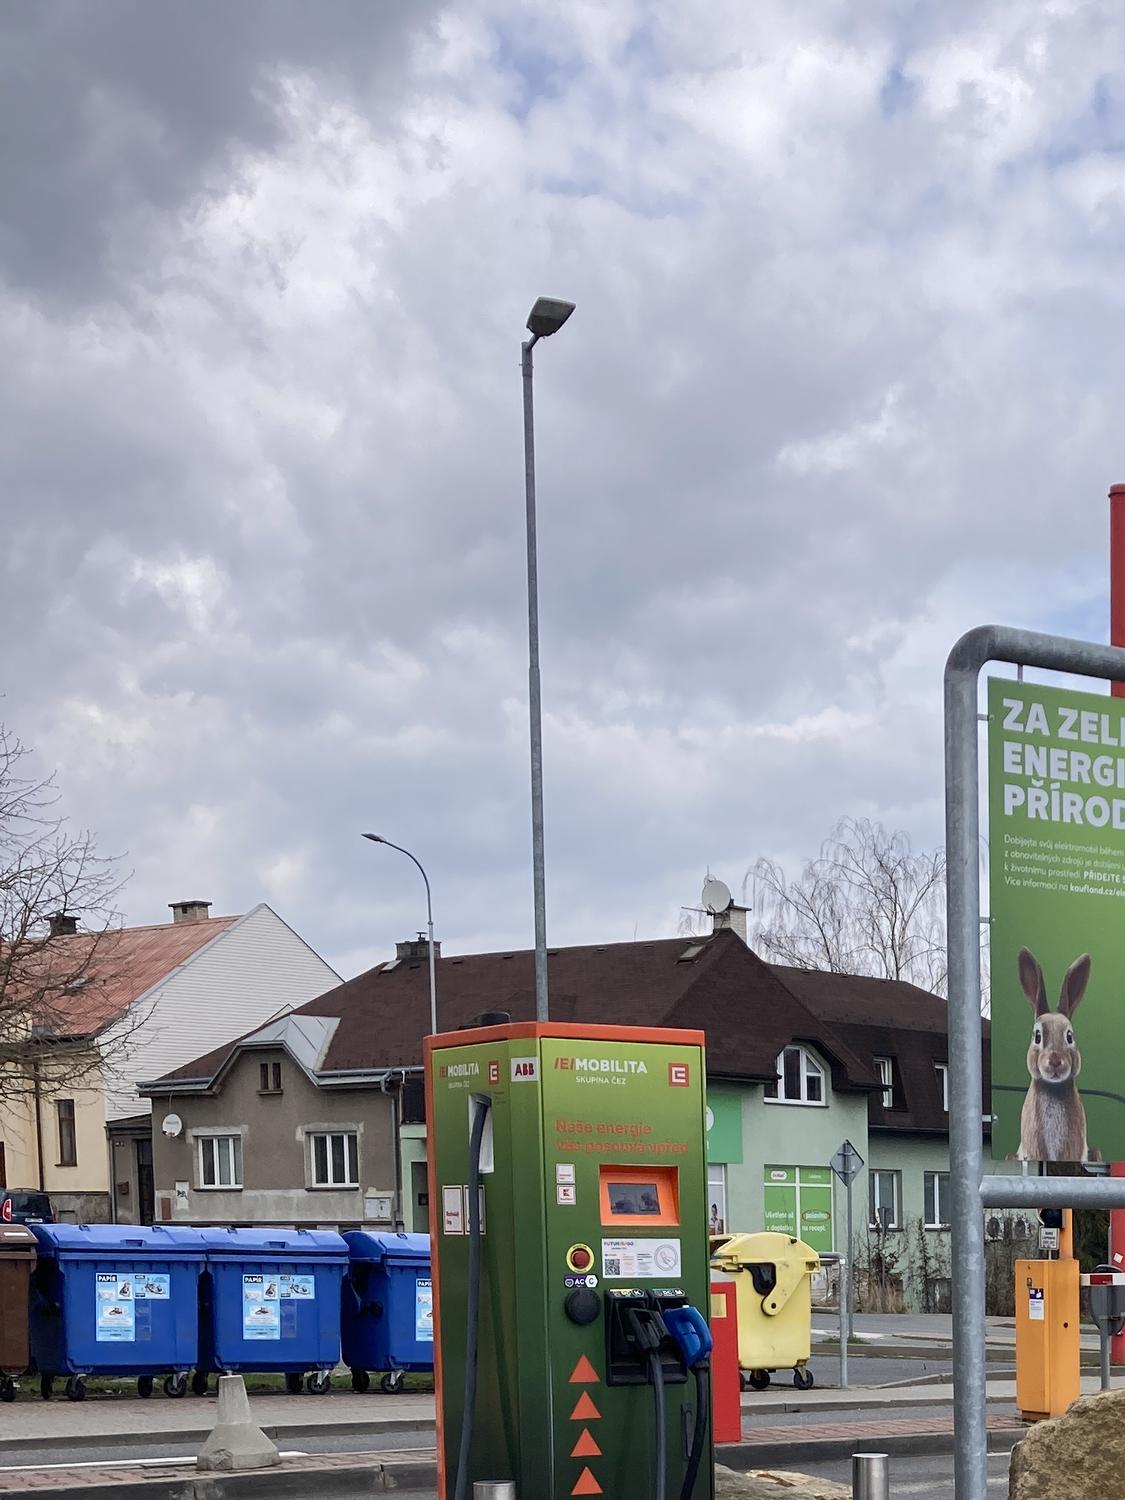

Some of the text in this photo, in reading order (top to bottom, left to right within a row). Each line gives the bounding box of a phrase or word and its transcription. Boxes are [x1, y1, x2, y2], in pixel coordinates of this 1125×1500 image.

[1002, 697, 1050, 736] ZA
[1059, 883, 1069, 892] na
[515, 1063, 535, 1076] ABB
[575, 1074, 627, 1085] SKUPINA ČEZ
[556, 1119, 652, 1137] Naše energie
